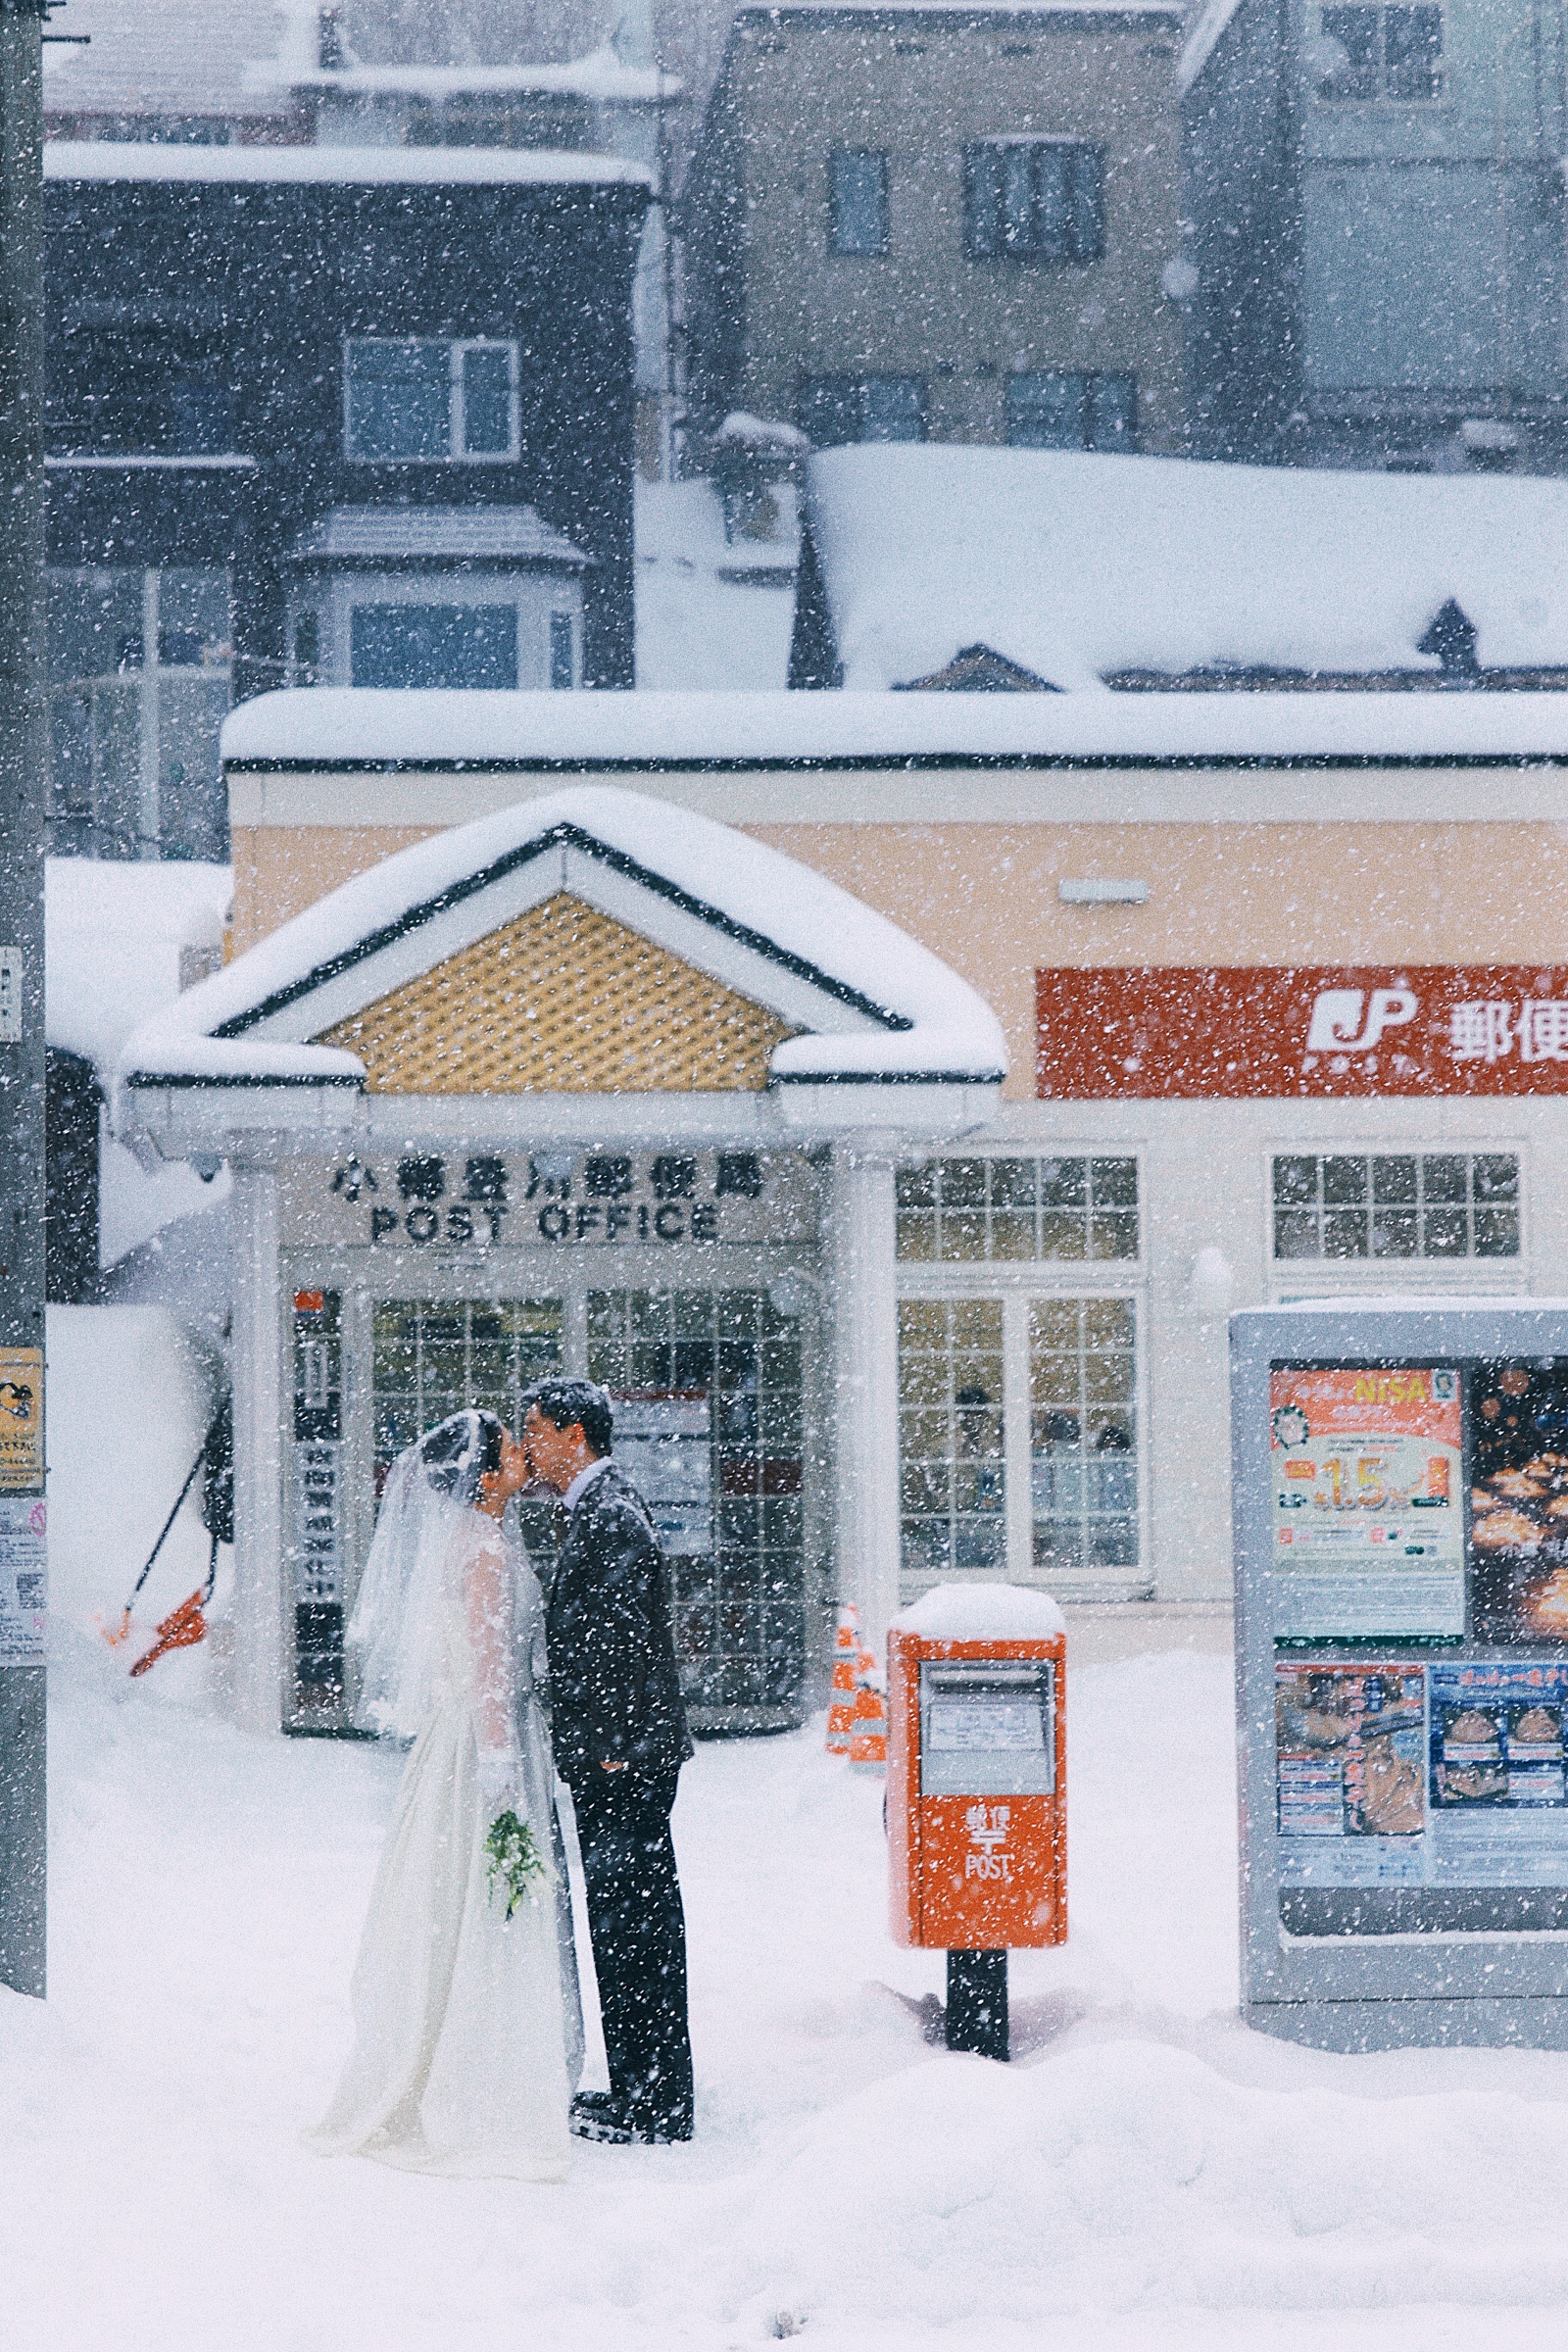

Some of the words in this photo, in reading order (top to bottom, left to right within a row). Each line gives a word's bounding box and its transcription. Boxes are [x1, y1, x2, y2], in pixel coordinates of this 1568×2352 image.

[1450, 999, 1568, 1063] 郵便
[370, 1205, 509, 1243] POST
[537, 1203, 719, 1243] OFFICE
[1355, 1376, 1427, 1403] NISA
[965, 1854, 1012, 1881] POST
